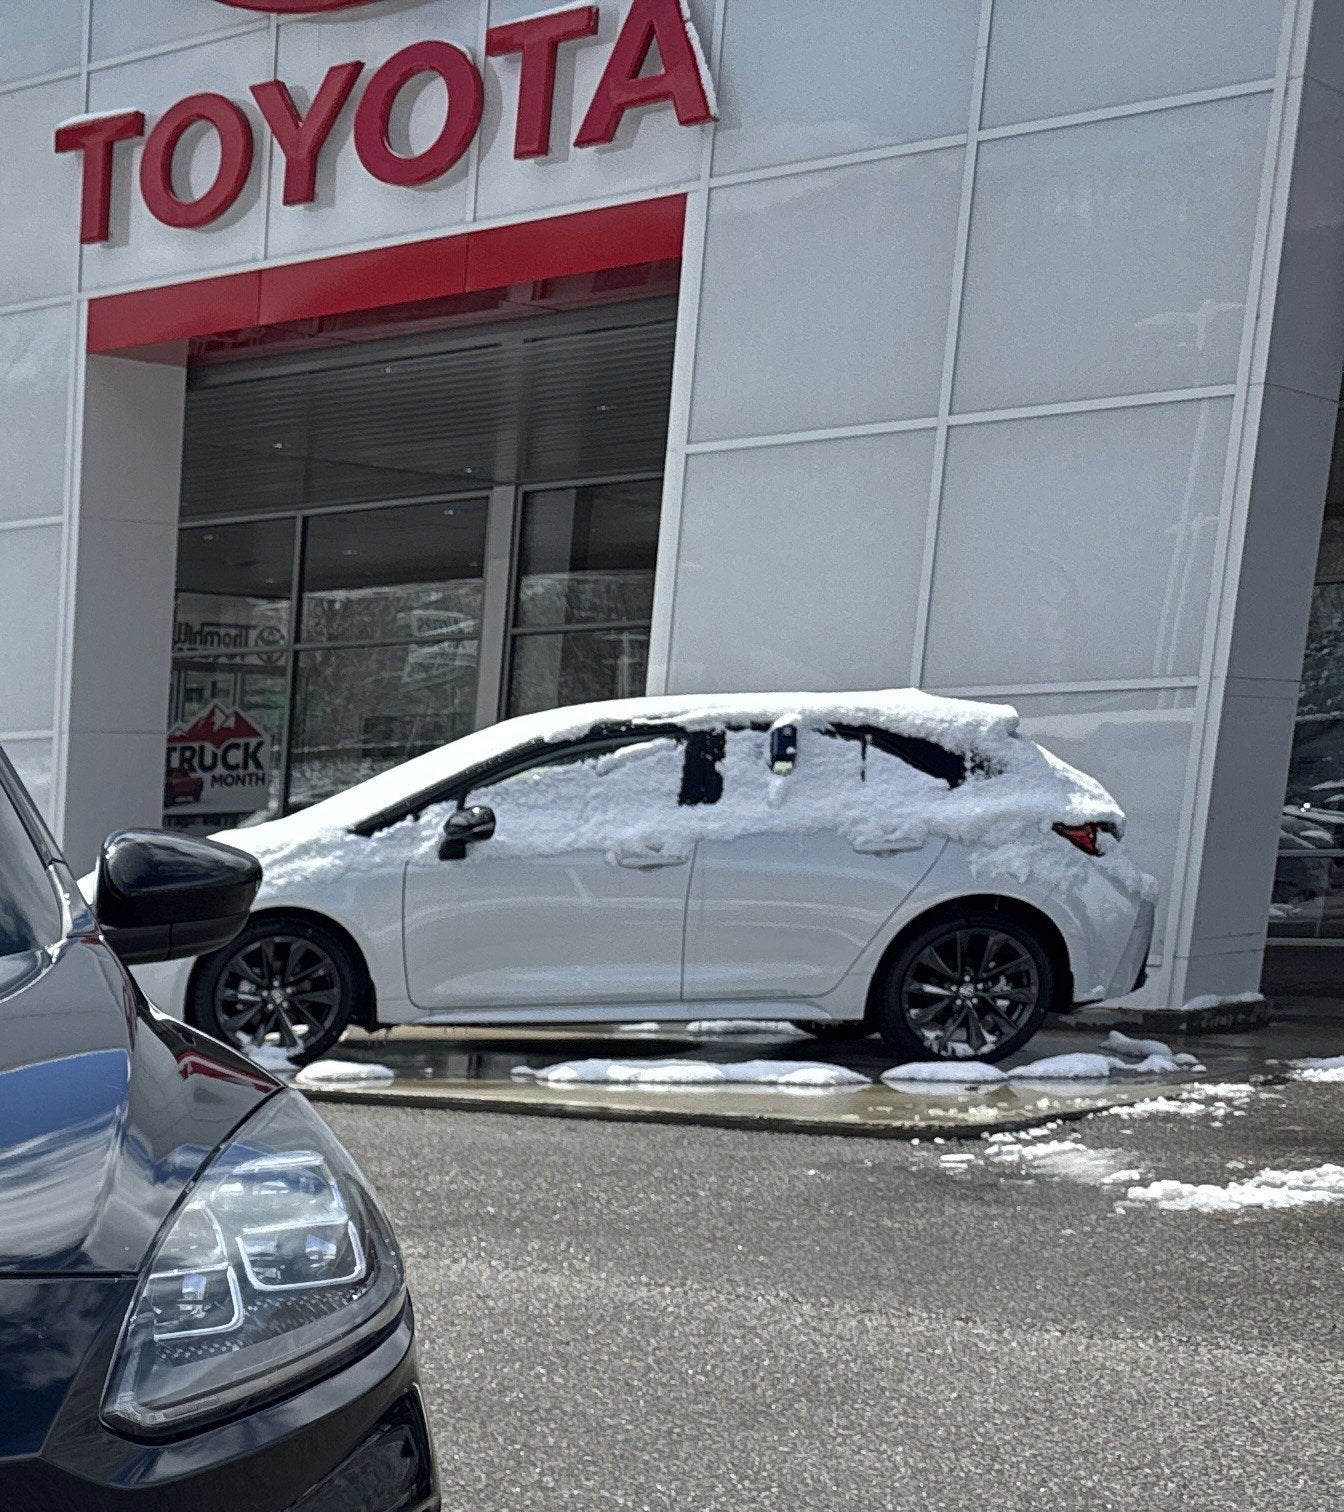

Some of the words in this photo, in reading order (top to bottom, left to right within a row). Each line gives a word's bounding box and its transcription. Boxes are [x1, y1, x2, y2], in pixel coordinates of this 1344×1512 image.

[54, 0, 718, 245] TOYOTA
[166, 741, 264, 773] TRUCK
[211, 772, 265, 787] MONTH
